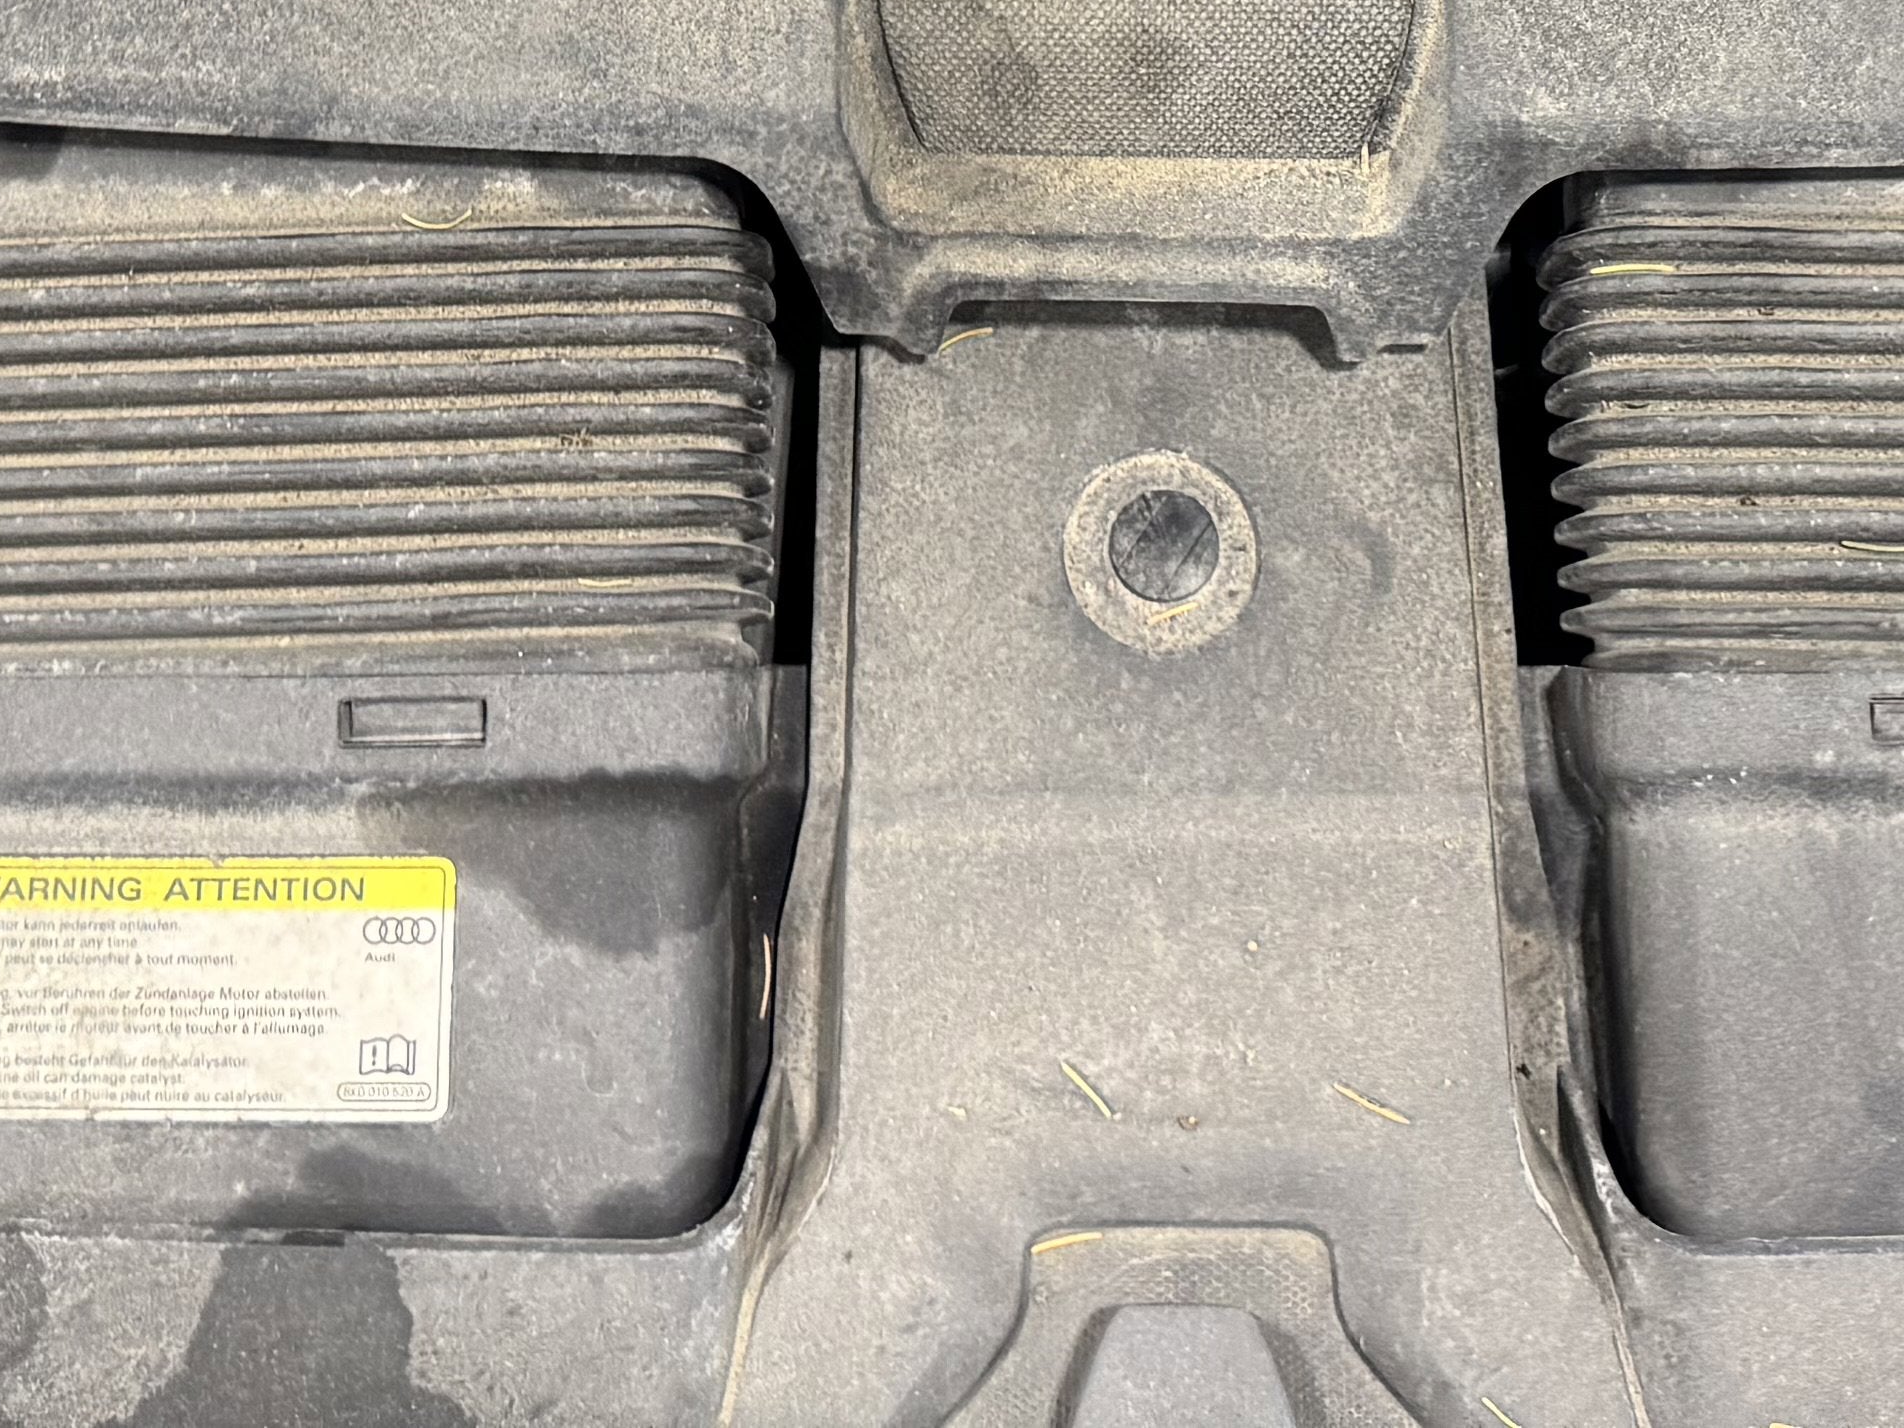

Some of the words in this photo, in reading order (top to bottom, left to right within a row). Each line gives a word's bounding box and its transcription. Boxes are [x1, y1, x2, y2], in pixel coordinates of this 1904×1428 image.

[163, 877, 366, 903] ATTENTION
[24, 919, 55, 931] kann
[80, 938, 104, 951] any
[147, 953, 173, 965] tout
[364, 952, 396, 963] Audi
[109, 987, 130, 1000] der
[219, 987, 260, 1000] Motor
[1, 1002, 47, 1016] Switch
[51, 1001, 69, 1015] off
[122, 1002, 165, 1017] before
[170, 1003, 229, 1020] touching
[233, 1003, 285, 1020] ignition
[185, 1021, 237, 1034] toucher
[23, 1070, 40, 1083] oil
[43, 1073, 68, 1084] can
[71, 1070, 127, 1087] damage
[120, 1090, 151, 1103] peut
[155, 1090, 190, 1103] nuire
[194, 1092, 210, 1102] au
